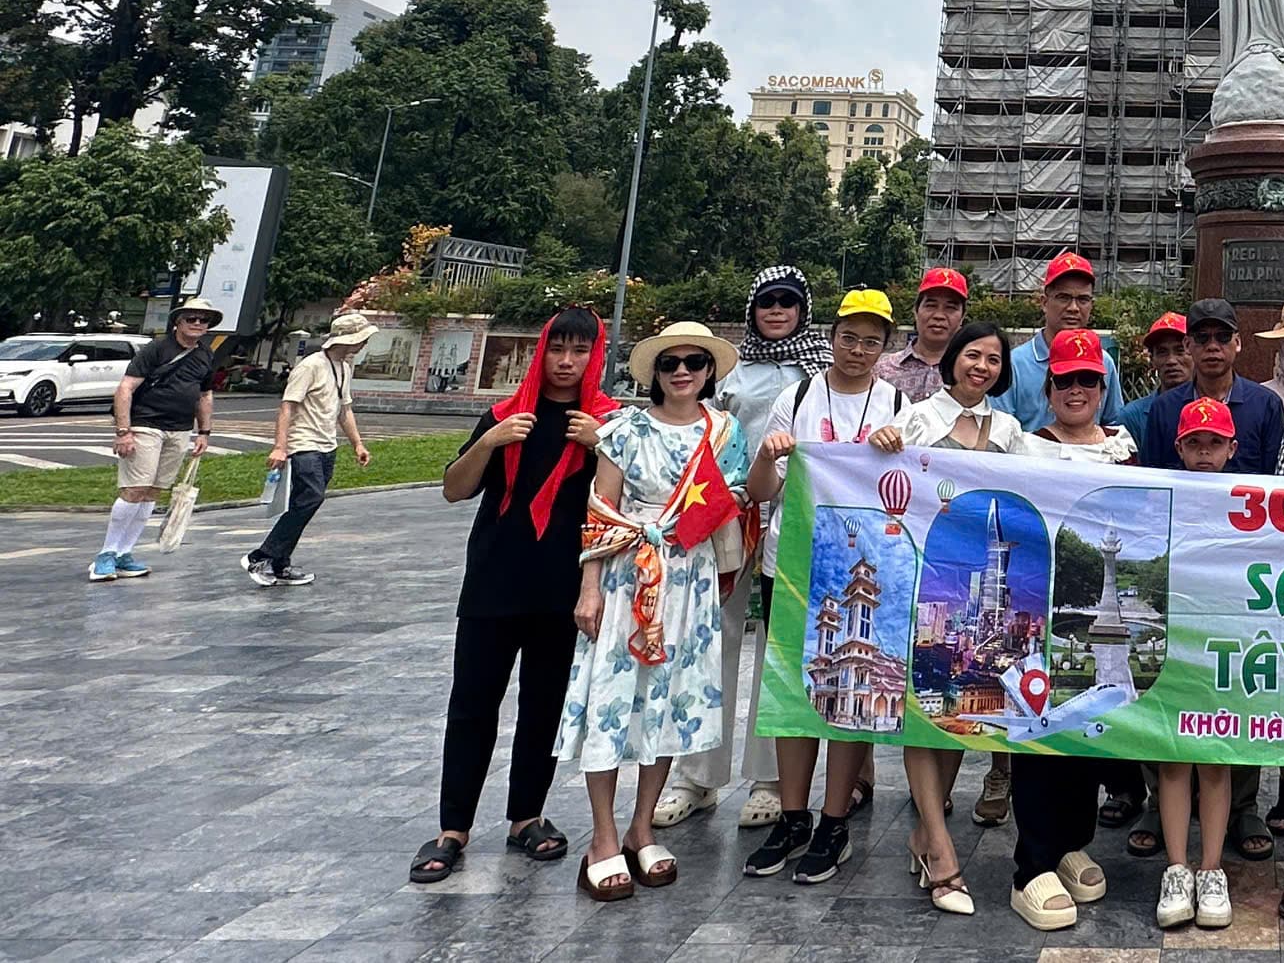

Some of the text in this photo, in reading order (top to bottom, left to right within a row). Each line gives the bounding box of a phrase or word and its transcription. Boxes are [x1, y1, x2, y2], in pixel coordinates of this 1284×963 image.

[768, 75, 866, 88] SACOMBANK
[1232, 246, 1280, 261] REGIA
[1180, 710, 1239, 736] KHỞI
